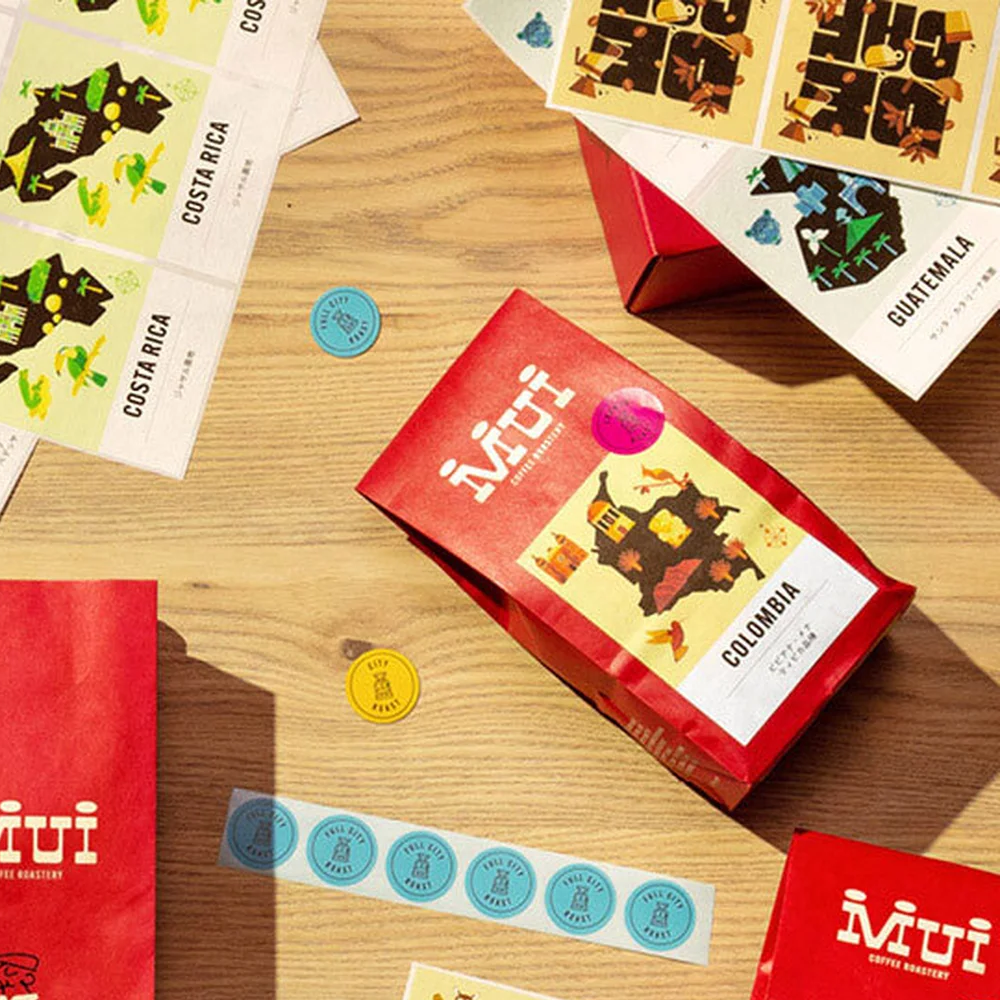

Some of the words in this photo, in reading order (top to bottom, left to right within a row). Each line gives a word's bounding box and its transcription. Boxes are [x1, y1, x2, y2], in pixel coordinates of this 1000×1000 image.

[240, 0, 266, 34] COS
[181, 166, 214, 226] COSTA
[203, 120, 230, 165] RICA
[887, 235, 975, 327] GUATEMALA
[123, 361, 155, 418] COSTA
[149, 313, 171, 359] RICA
[721, 581, 801, 668] COLOMBIA
[17, 869, 63, 880] ROASTERY
[868, 954, 901, 969] COFFEE
[903, 961, 950, 980] ROASTERY
